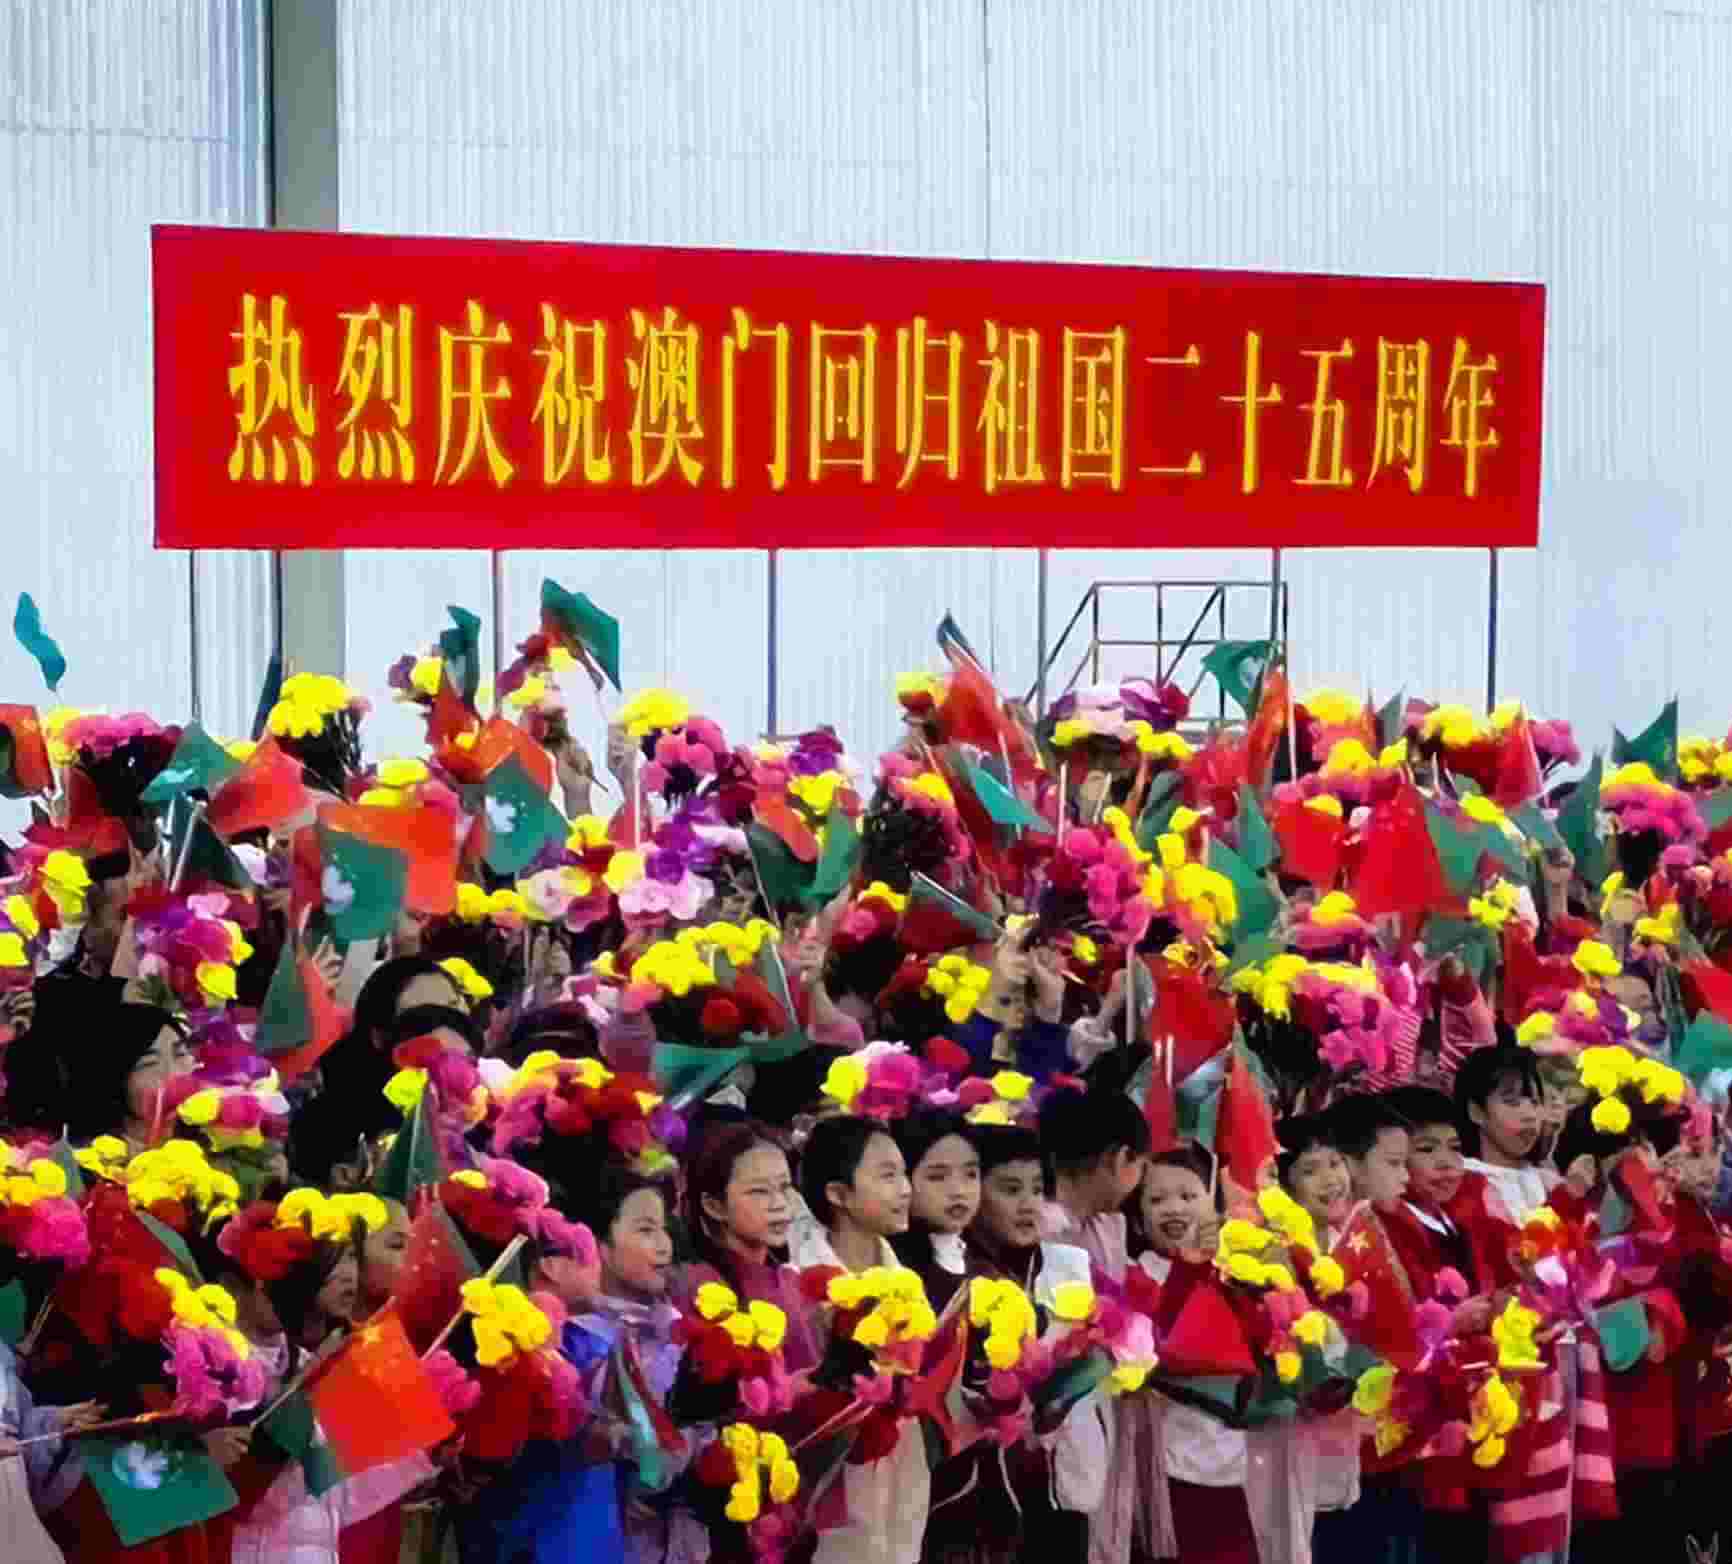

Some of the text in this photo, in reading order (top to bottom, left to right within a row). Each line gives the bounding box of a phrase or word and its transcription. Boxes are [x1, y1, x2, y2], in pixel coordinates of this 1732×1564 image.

[228, 293, 1500, 499] 热烈庆祝澳门回归祖国二十五周年
